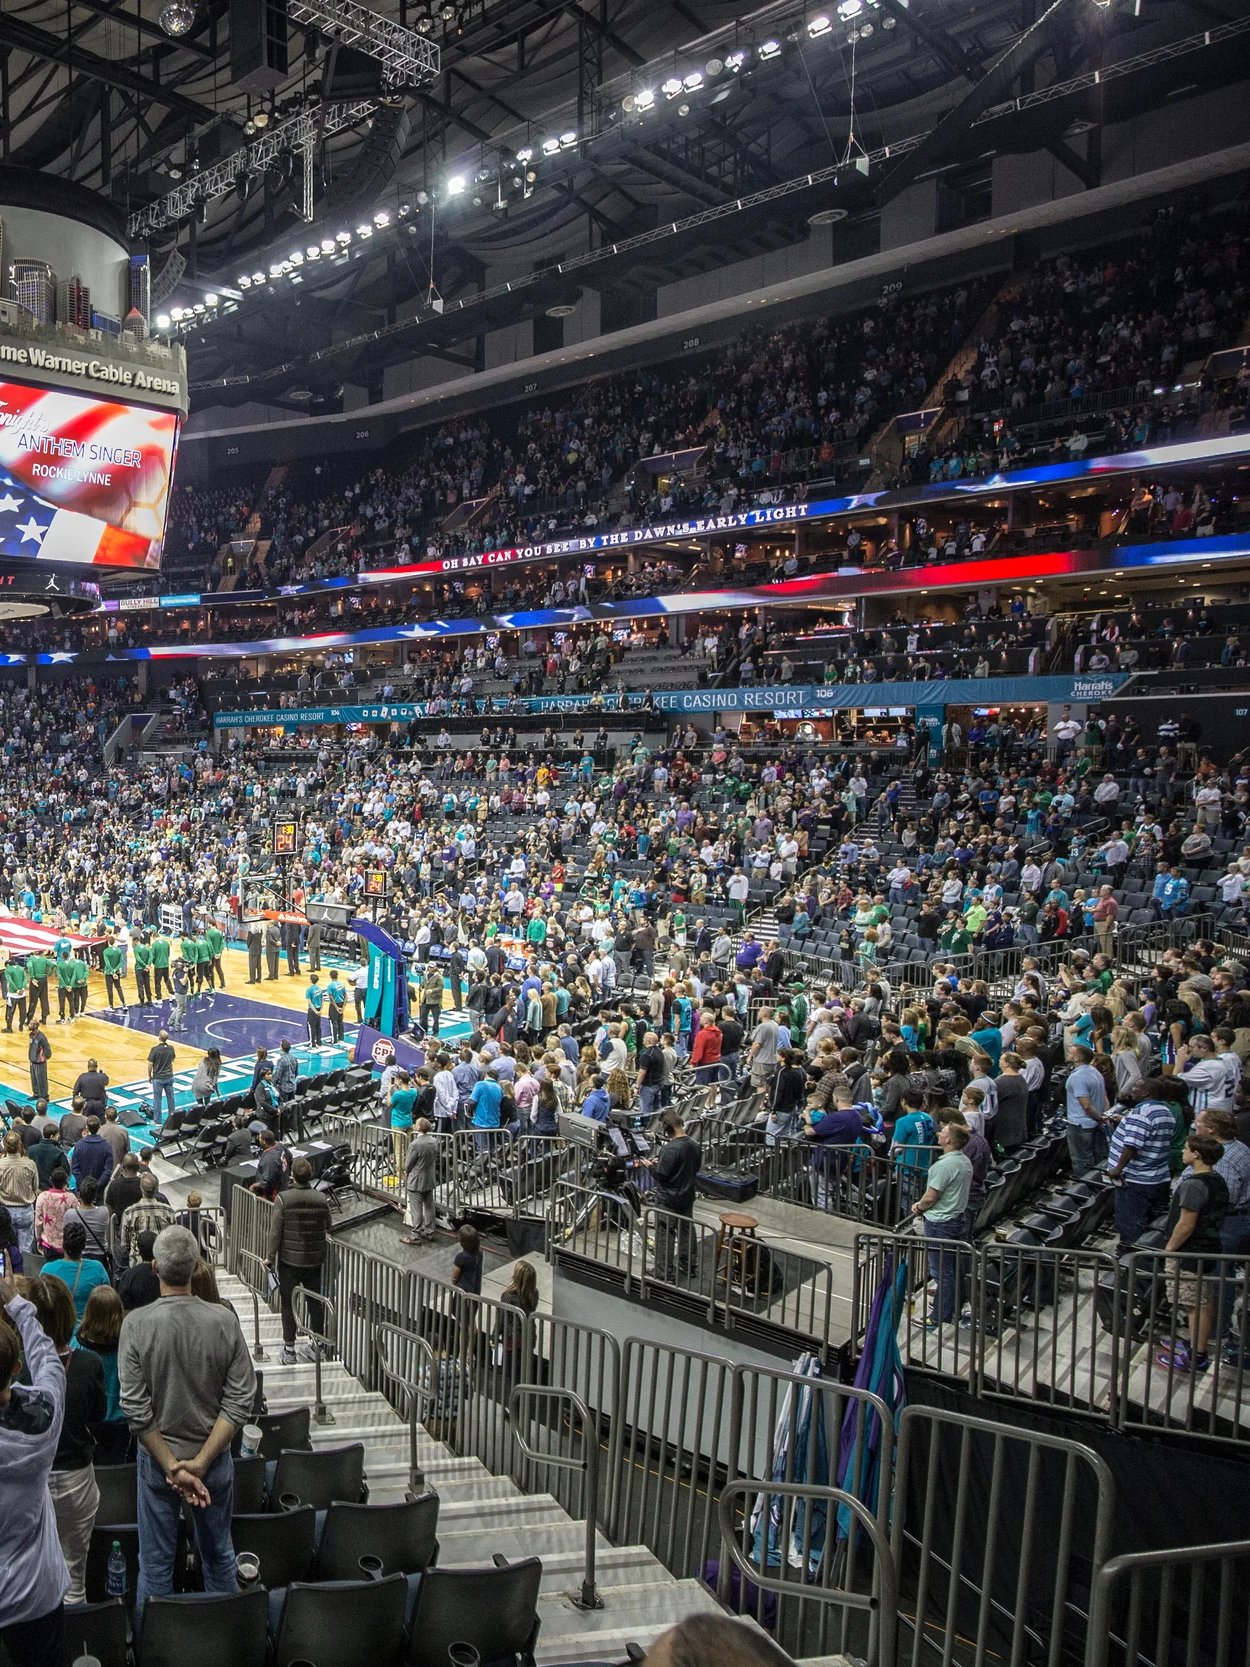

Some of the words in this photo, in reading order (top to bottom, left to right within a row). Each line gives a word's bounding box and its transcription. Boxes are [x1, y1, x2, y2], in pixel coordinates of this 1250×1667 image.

[882, 281, 903, 295] 209
[683, 337, 700, 350] 208
[28, 347, 88, 376] Warner
[88, 360, 132, 385] Cable
[134, 370, 180, 394] Arena
[524, 382, 538, 393] 207
[355, 430, 370, 439] 206
[17, 433, 86, 458] ANTHEM
[89, 444, 142, 468] SINGER
[226, 447, 239, 455] 205
[32, 463, 74, 481] ROCKIE
[77, 471, 112, 486] LYNNE
[442, 559, 458, 570] OH
[462, 555, 484, 567] SAY
[488, 551, 512, 563] CAN
[515, 546, 542, 559] YOU
[546, 541, 570, 555] SEE
[579, 537, 596, 549] BY
[601, 532, 629, 546] THE
[634, 522, 690, 541] DAWN'S
[696, 513, 748, 531] EARLY
[754, 504, 808, 523] LIGHT
[1074, 680, 1113, 691] Harrah's
[683, 694, 737, 708] CASINO
[744, 690, 806, 706] RESORT
[816, 689, 834, 698] 106
[216, 715, 243, 724] HARRAH'S
[244, 714, 274, 723] CHEROKEE
[276, 713, 298, 722] CASINO
[301, 712, 325, 721] RESORT
[1235, 708, 1248, 716] 107
[277, 835, 293, 850] 24
[369, 882, 382, 891] 24
